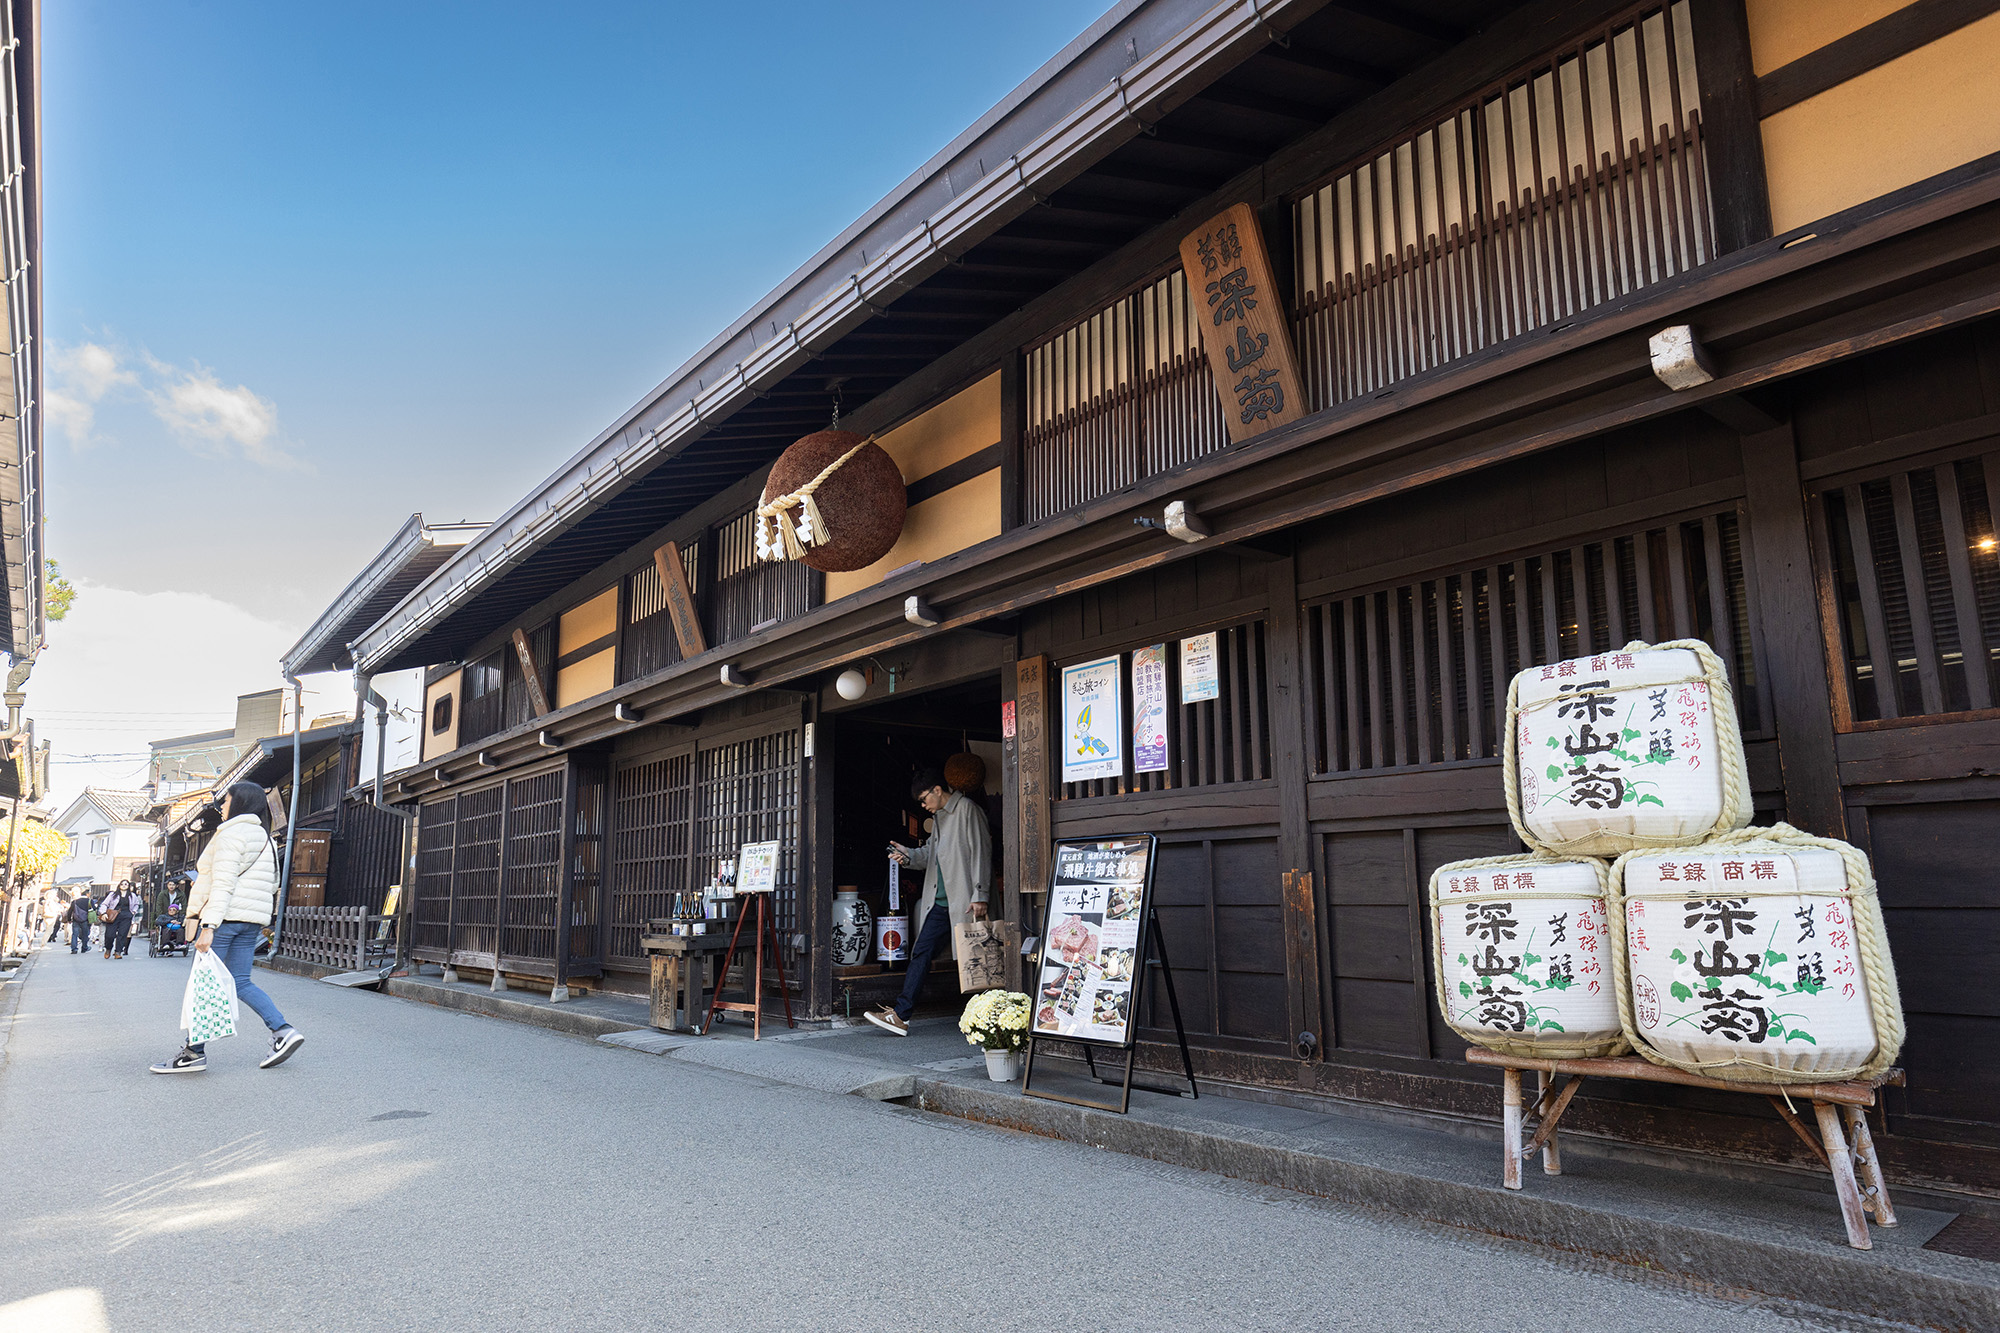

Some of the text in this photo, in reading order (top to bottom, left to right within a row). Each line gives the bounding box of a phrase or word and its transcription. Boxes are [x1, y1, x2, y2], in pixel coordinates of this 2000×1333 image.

[1205, 266, 1285, 424] 深山菊
[1072, 677, 1110, 696] ぎふ旅コイン
[1136, 666, 1145, 697] 加盟店
[1145, 664, 1154, 744] 教育旅行クーポン
[1153, 662, 1163, 703] 飛騨高山
[1020, 691, 1041, 775] 深山菊
[1557, 680, 1625, 811] 深山菊
[1063, 860, 1139, 879] 飛騨牛御食事処
[1087, 850, 1127, 860] 地酒が楽しめる
[1464, 902, 1527, 1033] 深山菊
[1684, 889, 1769, 1044] 深山菊
